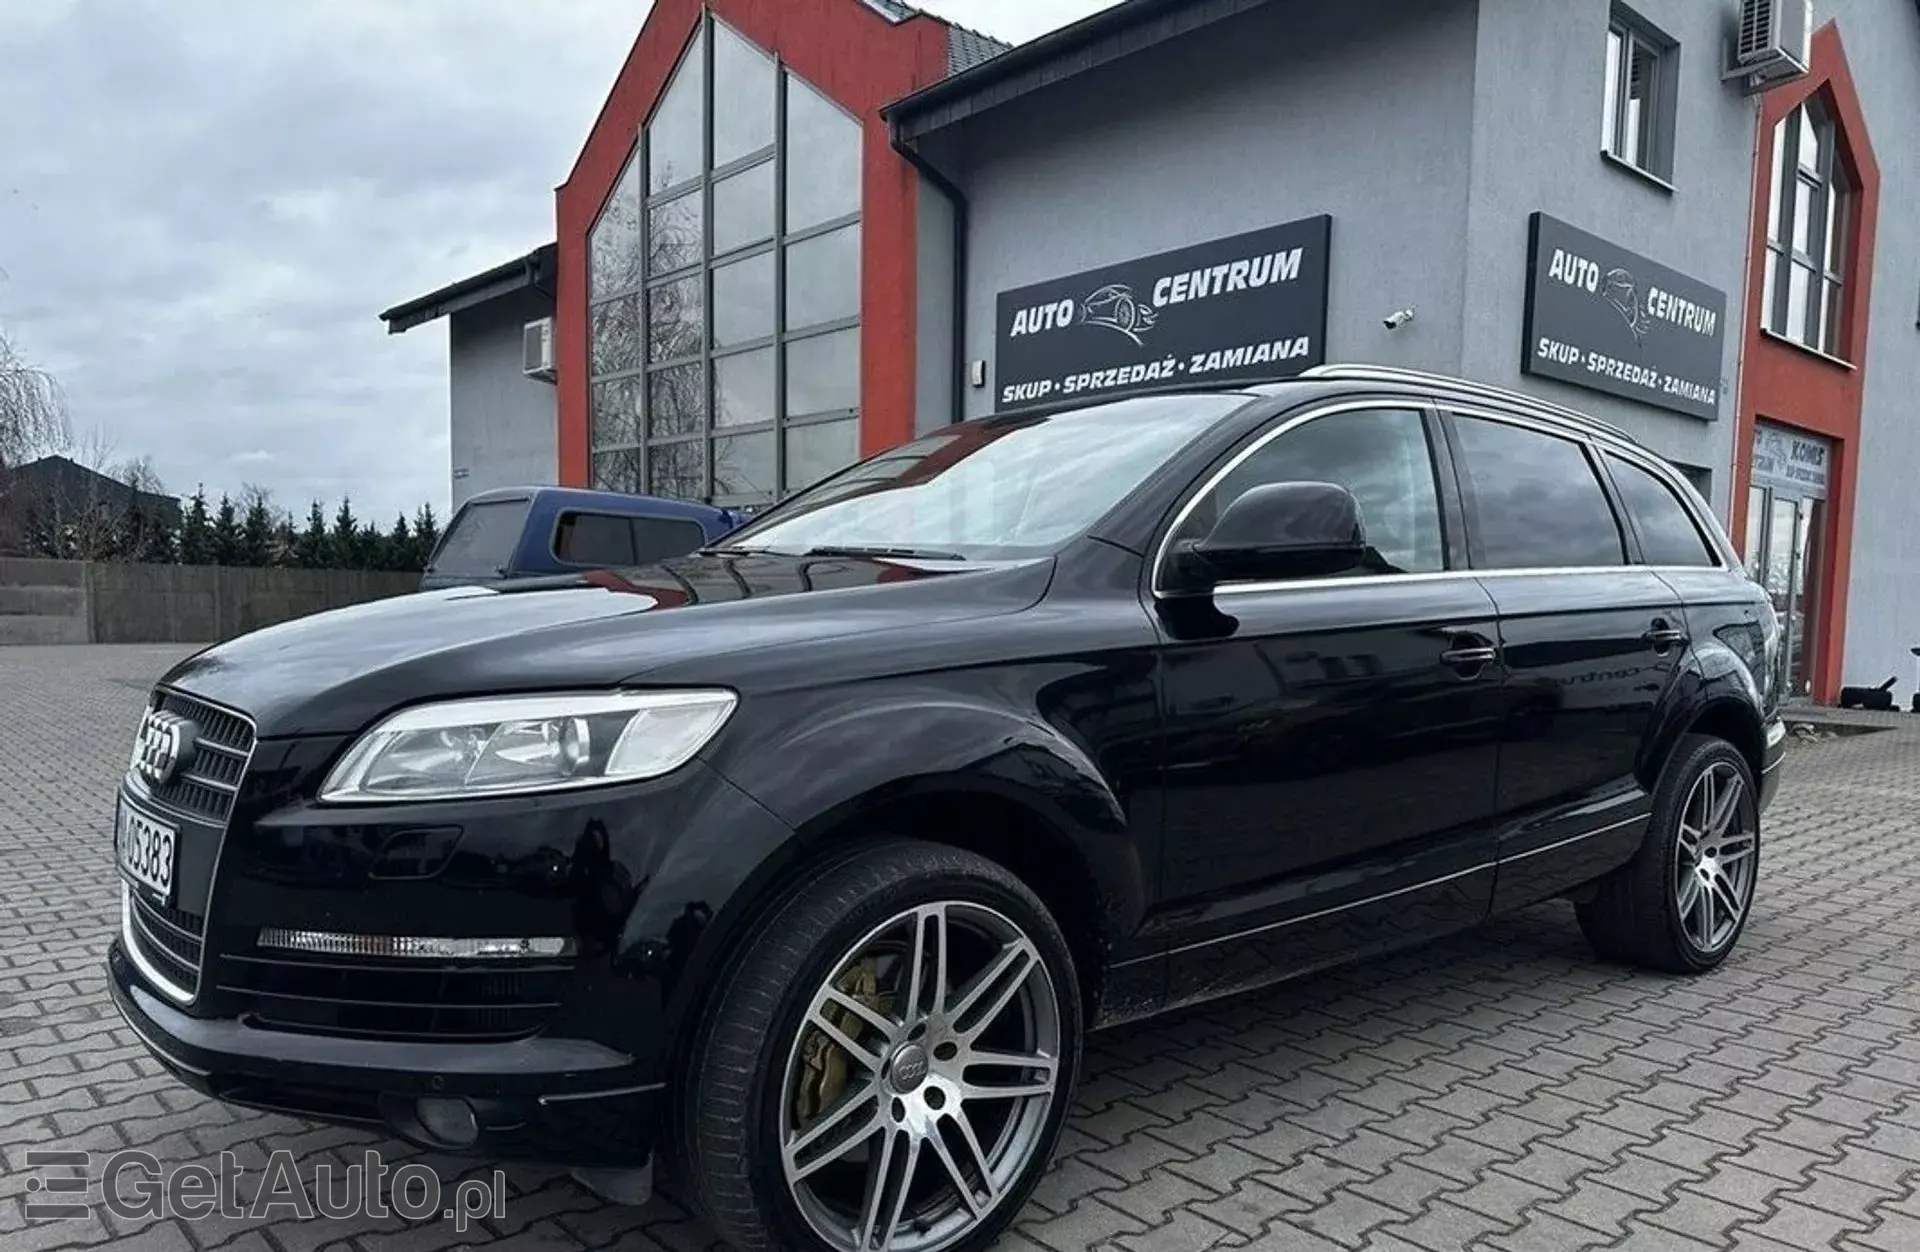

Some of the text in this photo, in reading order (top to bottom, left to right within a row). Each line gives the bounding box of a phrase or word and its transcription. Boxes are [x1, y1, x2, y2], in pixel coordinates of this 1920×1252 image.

[1010, 248, 1303, 337] AUTO CENTRUM
[1549, 248, 1716, 336] AUTO CENTRUM
[1002, 336, 1310, 404] SKUP SPRZEDAŻ ZAMIANA
[1537, 337, 1580, 365] SKUP
[1663, 374, 1716, 405] ZAMIANA
